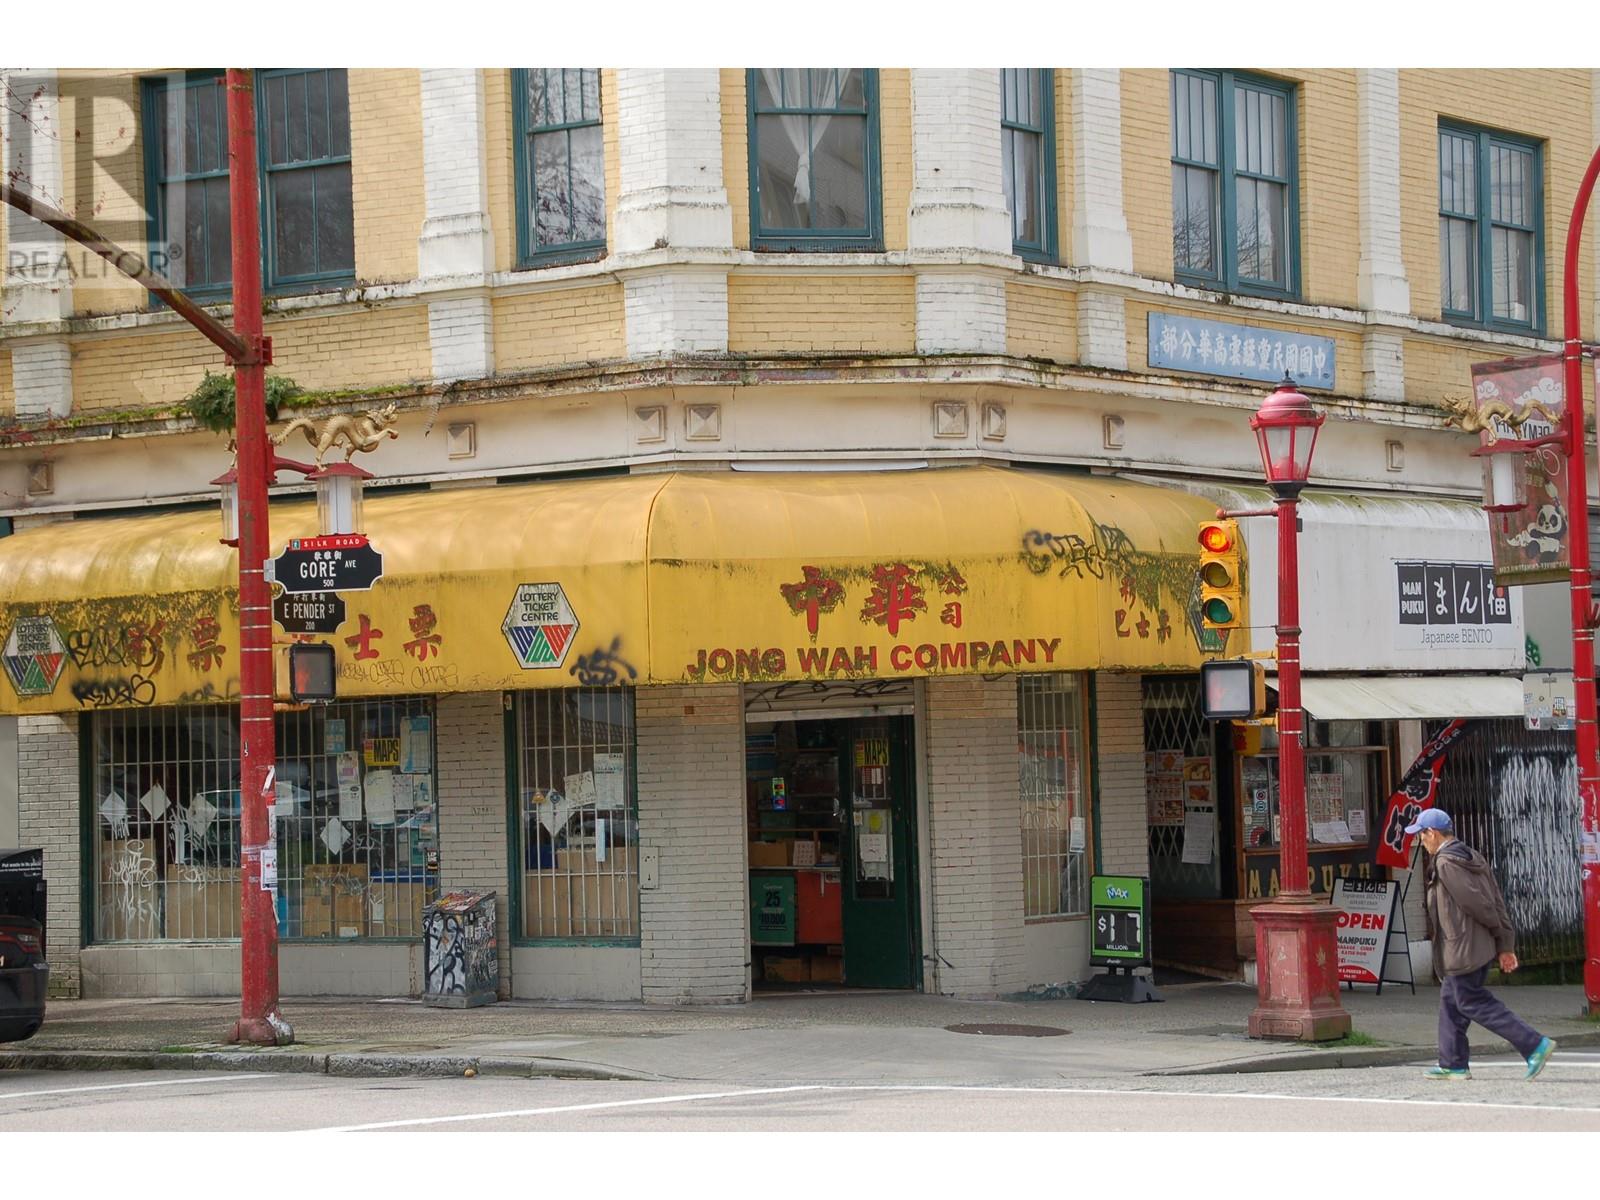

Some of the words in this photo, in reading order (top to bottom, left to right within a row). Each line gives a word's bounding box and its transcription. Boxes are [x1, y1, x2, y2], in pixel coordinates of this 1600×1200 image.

[300, 561, 337, 578] GORE
[344, 560, 356, 568] AVE
[322, 579, 334, 587] 500
[1402, 581, 1422, 595] MAN
[520, 592, 558, 603] LOTTERY
[284, 603, 289, 618] E
[293, 603, 325, 619] PENDER
[328, 604, 335, 613] ST
[524, 602, 555, 612] TICKET
[1402, 601, 1424, 614] PUKU
[521, 611, 559, 622] CENTRE
[305, 621, 315, 630] 200
[1420, 628, 1459, 647] Japanese
[1461, 628, 1493, 644] BENTO
[687, 648, 787, 675] JONG
[800, 647, 878, 673] WAH
[890, 638, 1061, 671] COMPANY
[373, 739, 399, 762] MAPS
[864, 740, 889, 766] MAPS
[1336, 911, 1385, 930] OPEN
